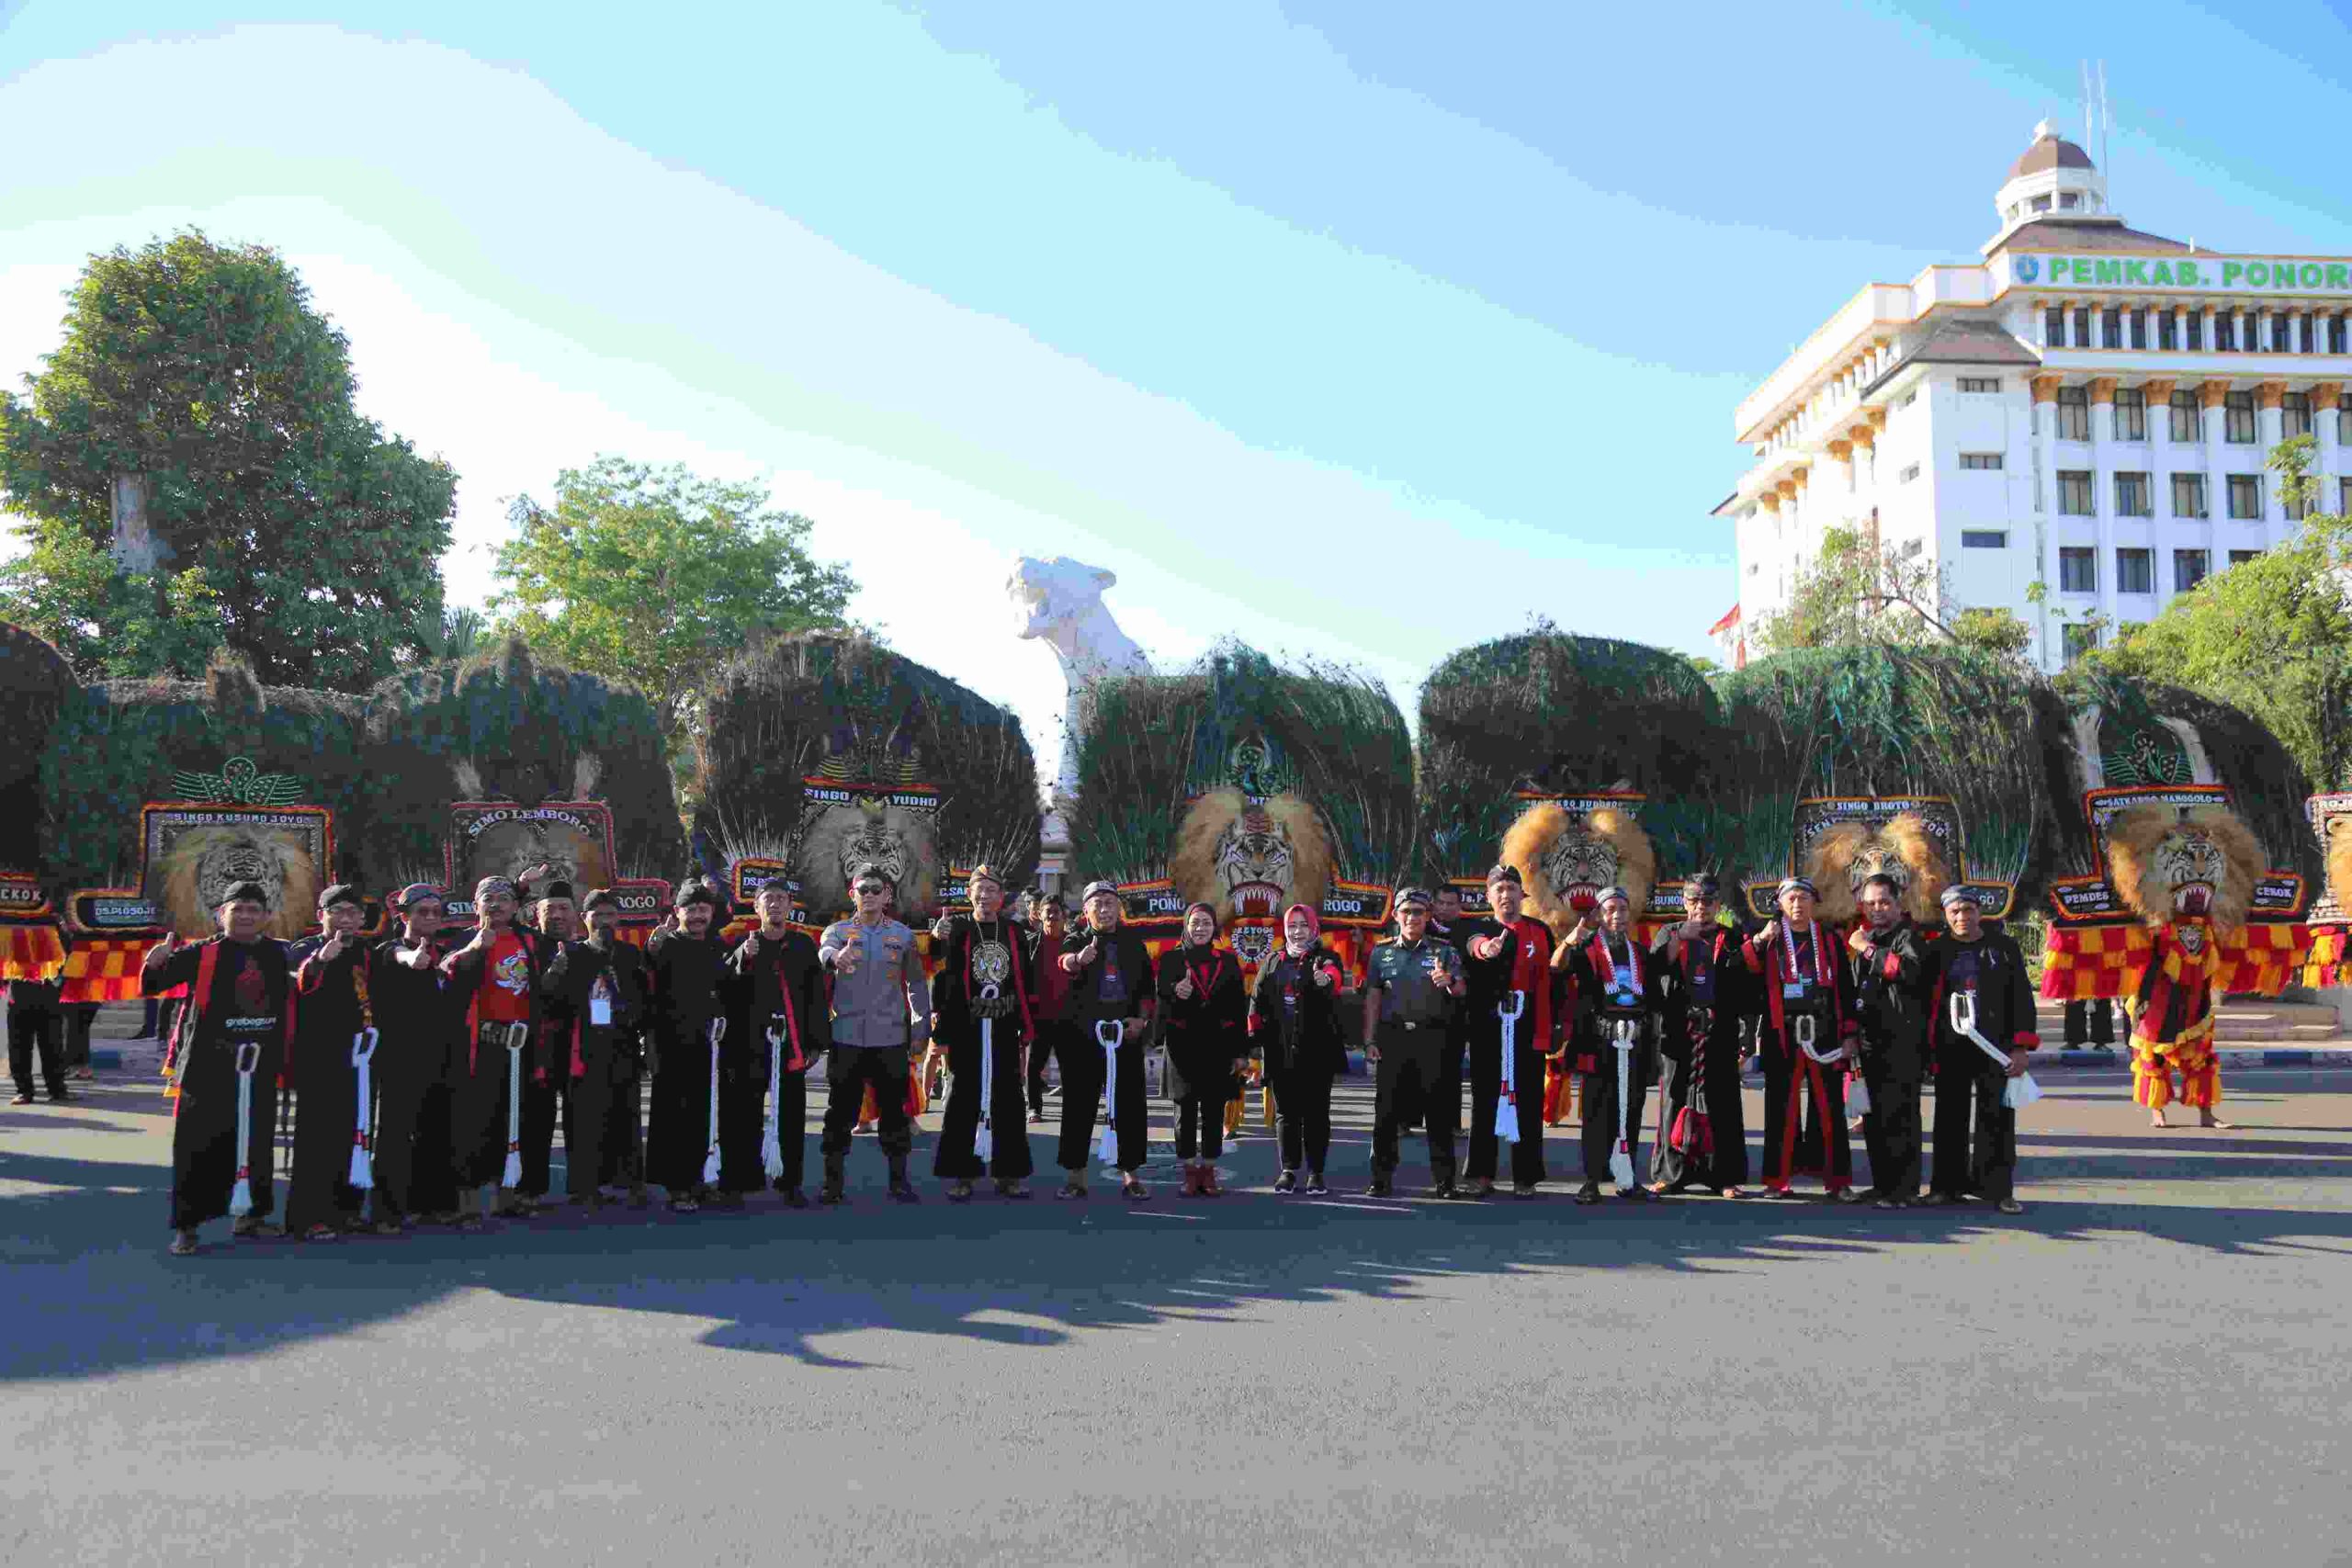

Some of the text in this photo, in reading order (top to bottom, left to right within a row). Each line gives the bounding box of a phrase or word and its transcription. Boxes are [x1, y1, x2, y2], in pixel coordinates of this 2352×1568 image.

[2049, 257, 2210, 287] PEMKAB.
[804, 788, 938, 807] SINGO YUDHO
[1837, 801, 1869, 810] SINGO
[174, 812, 213, 822] SINGO
[217, 813, 267, 823] KUSUMO
[469, 808, 591, 837] SIMO LEMBORO
[1149, 897, 1186, 911] PONO
[2064, 891, 2109, 905] PEMDES
[1323, 899, 1361, 912] ROGO
